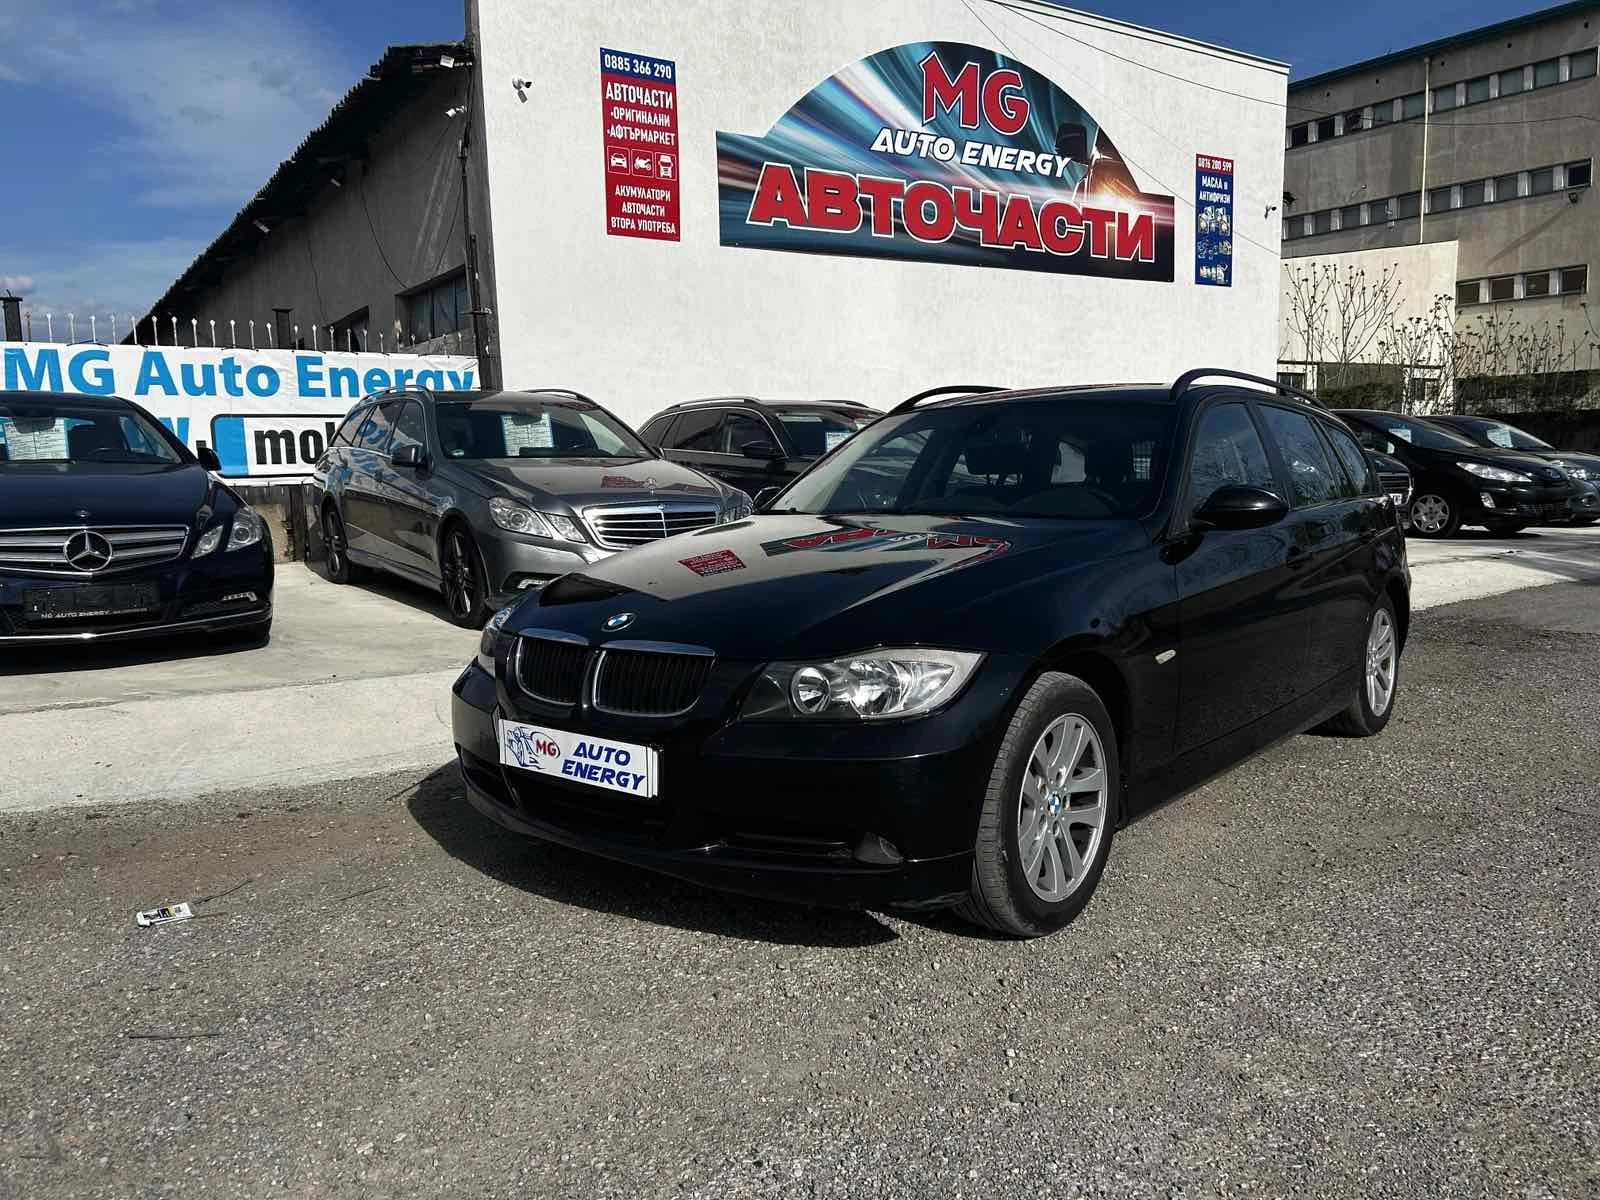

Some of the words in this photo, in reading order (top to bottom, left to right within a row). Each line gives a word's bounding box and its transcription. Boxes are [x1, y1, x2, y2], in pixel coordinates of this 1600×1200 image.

[604, 54, 630, 72] 0885
[632, 59, 652, 76] 366
[654, 63, 672, 80] 290
[605, 81, 674, 110] АВТОЧАСТИ
[920, 50, 1031, 137] MG
[870, 128, 956, 162] AUTO
[961, 141, 1072, 178] ENERGY
[615, 184, 671, 202] АКУМУЛАТОРИ
[622, 201, 665, 217] АВТОЧАСТИ
[746, 162, 1156, 264] АВТОЧАСТИ
[611, 216, 636, 230] ВТОРА
[638, 219, 676, 234] УПОТРЕБА
[4, 347, 116, 395] MG
[135, 351, 281, 397] Auto
[536, 739, 557, 758] MG
[573, 742, 631, 766] AUTO
[561, 759, 646, 790] ENERGY
